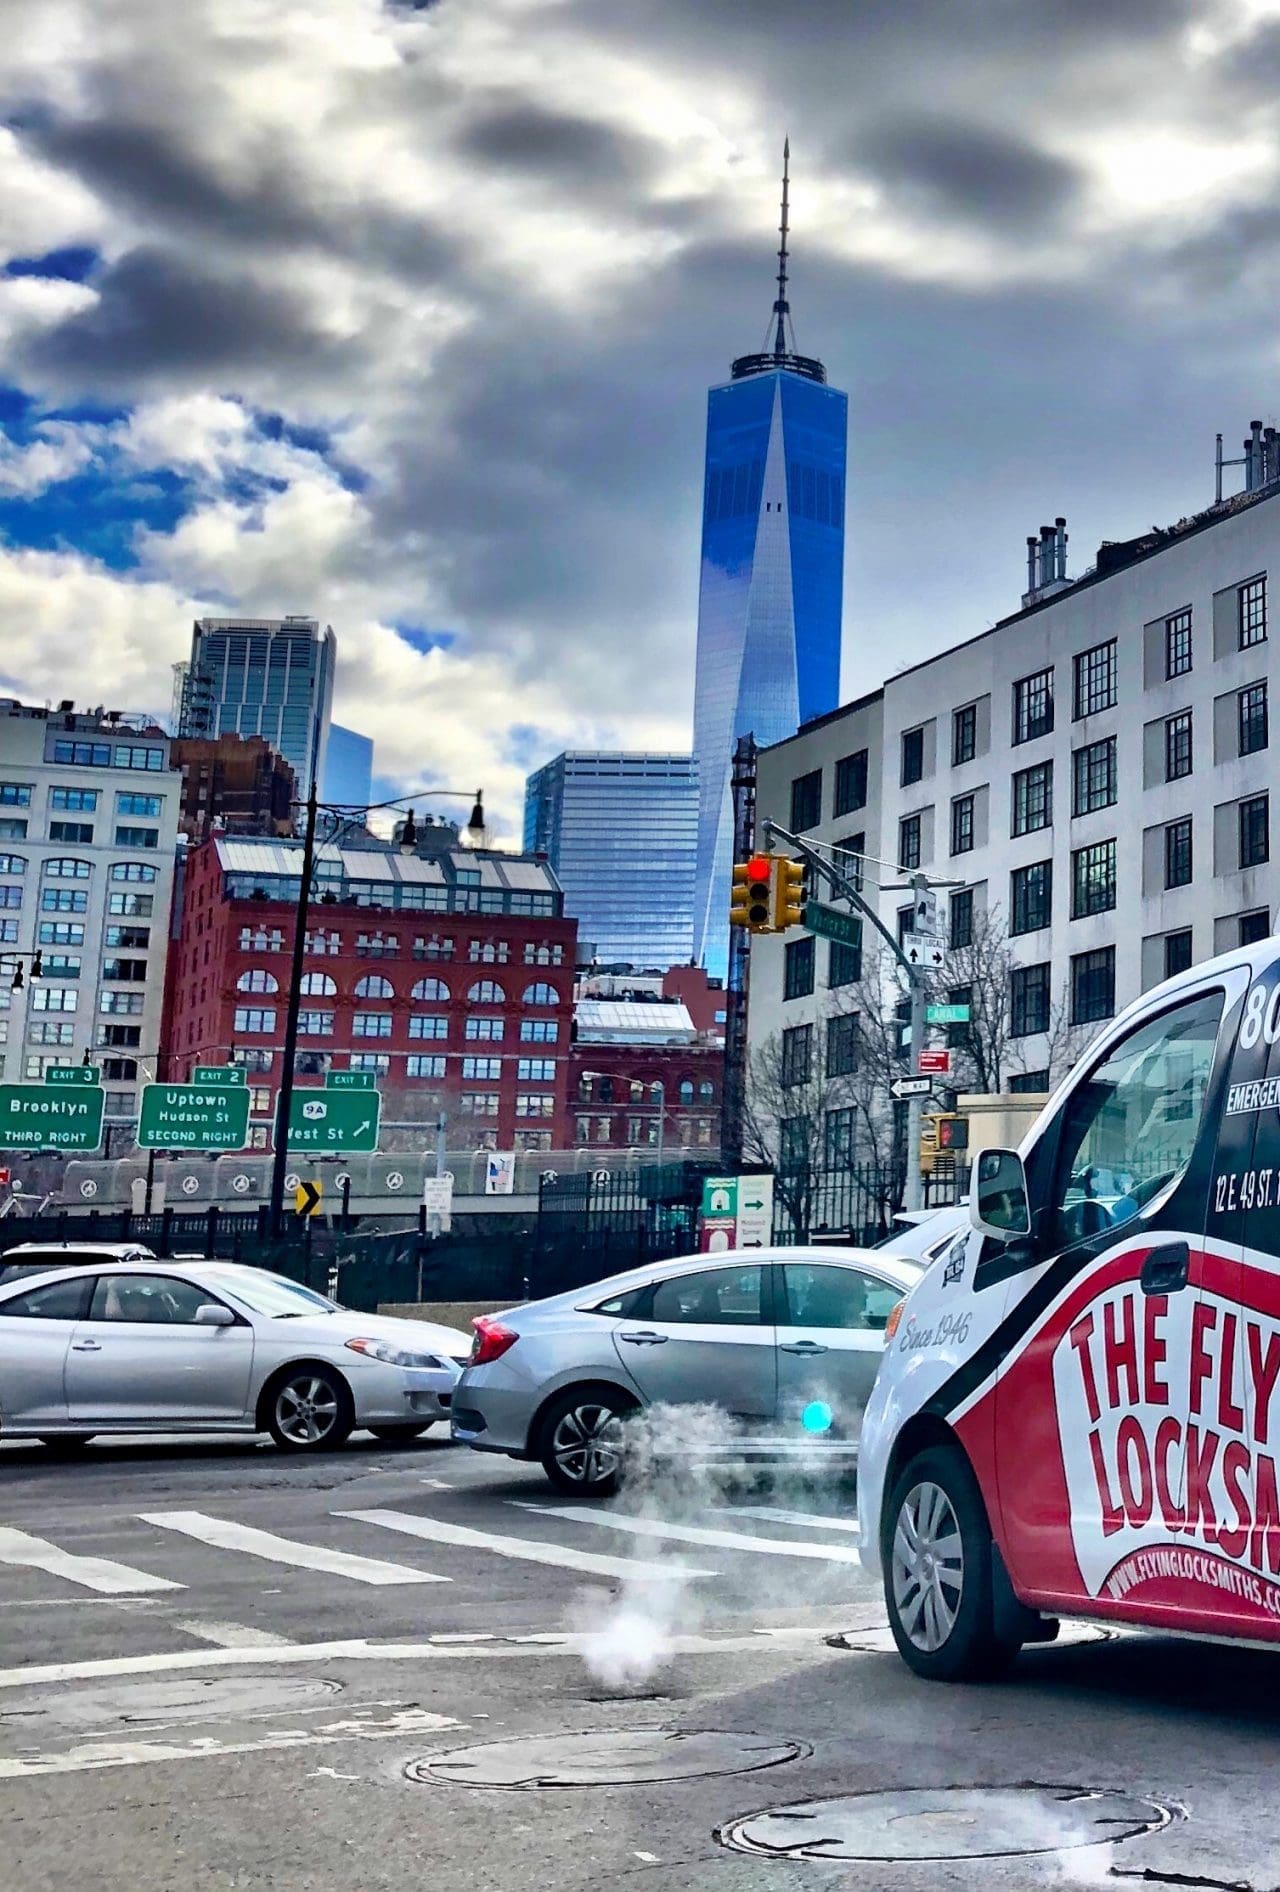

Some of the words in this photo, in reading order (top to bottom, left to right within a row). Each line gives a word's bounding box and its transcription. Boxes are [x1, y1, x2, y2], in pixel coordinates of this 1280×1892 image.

[52, 1070, 75, 1079] EXIT
[83, 1070, 93, 1082] 3
[200, 1071, 222, 1080] EXIT
[229, 1071, 240, 1083] 2
[334, 1075, 354, 1084] EXIT
[362, 1075, 368, 1086] 1
[166, 1092, 227, 1107] Uptown
[10, 1099, 88, 1117] Brooklyn
[306, 1105, 324, 1115] 9A
[159, 1111, 209, 1122] Hudson
[216, 1112, 230, 1123] St
[4, 1130, 43, 1142] THIRD
[49, 1132, 87, 1143] RIGHT
[147, 1130, 197, 1141] SECOND
[202, 1132, 238, 1142] RIGHT
[327, 1128, 344, 1140] St
[1215, 1175, 1227, 1213] 12
[1227, 1173, 1237, 1211] E.
[1240, 1170, 1256, 1209] 49
[1257, 1168, 1273, 1208] ST.
[900, 1317, 933, 1352] Since
[931, 1311, 972, 1346] 1946
[1069, 1293, 1169, 1423] THE
